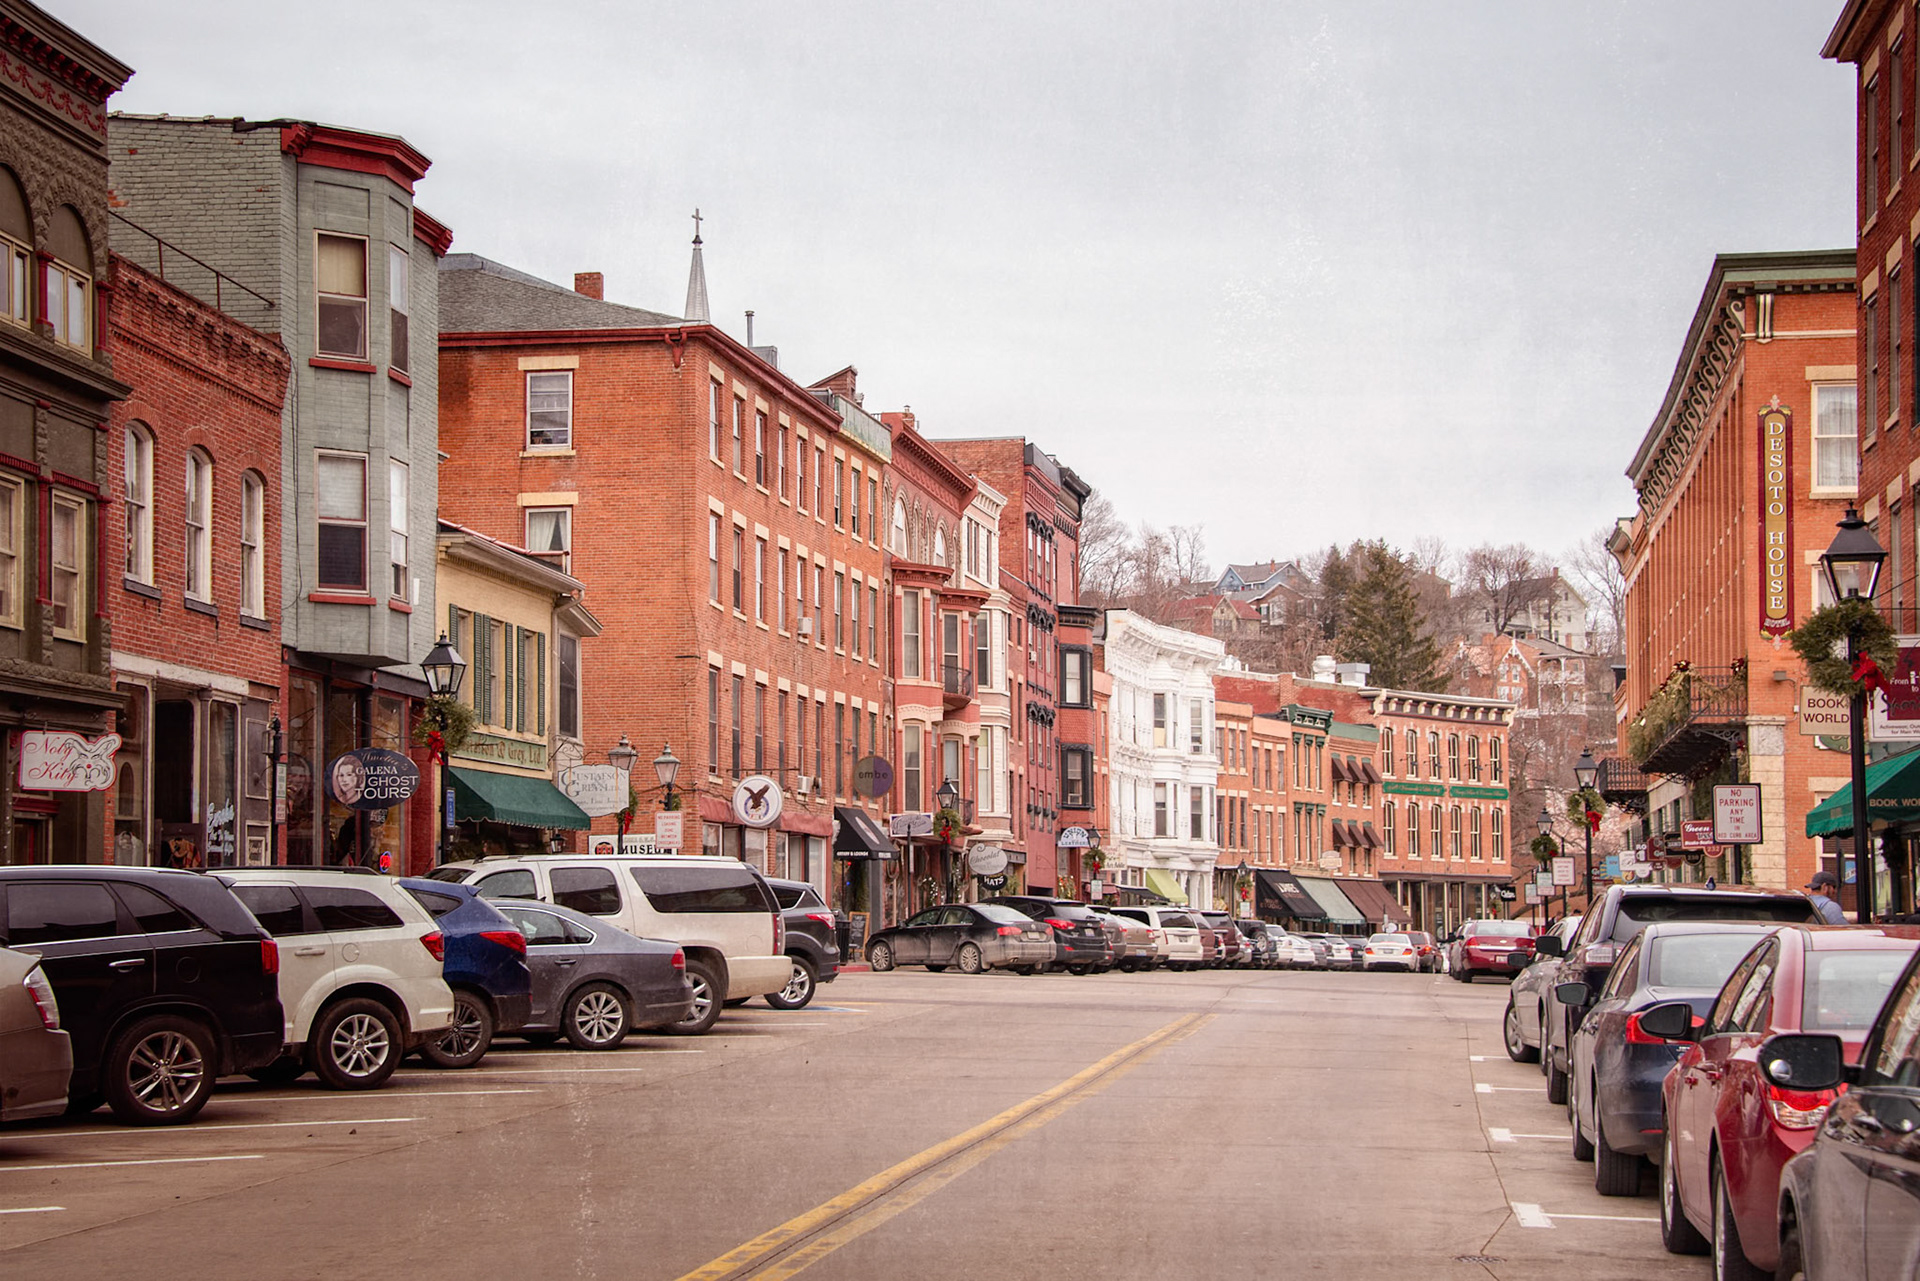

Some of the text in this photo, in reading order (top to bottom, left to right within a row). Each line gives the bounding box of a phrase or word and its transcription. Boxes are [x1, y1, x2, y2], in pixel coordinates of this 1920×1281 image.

[1768, 422, 1785, 610] DESOTO HOUSE
[1889, 677, 1909, 685] From
[1807, 698, 1845, 709] BOOK
[1803, 713, 1850, 724] WORLD
[355, 765, 398, 775] GALENA
[858, 770, 888, 779] embe
[367, 775, 419, 787] GHOST
[354, 786, 411, 799] TOURS
[1731, 789, 1742, 797] NO
[1719, 799, 1754, 807] PARKING
[1869, 799, 1920, 807] BOOK WO
[1063, 827, 1087, 838] UNION
[1684, 823, 1709, 832] Green
[970, 850, 1001, 865] Chocolat
[984, 875, 1004, 887] HATS
